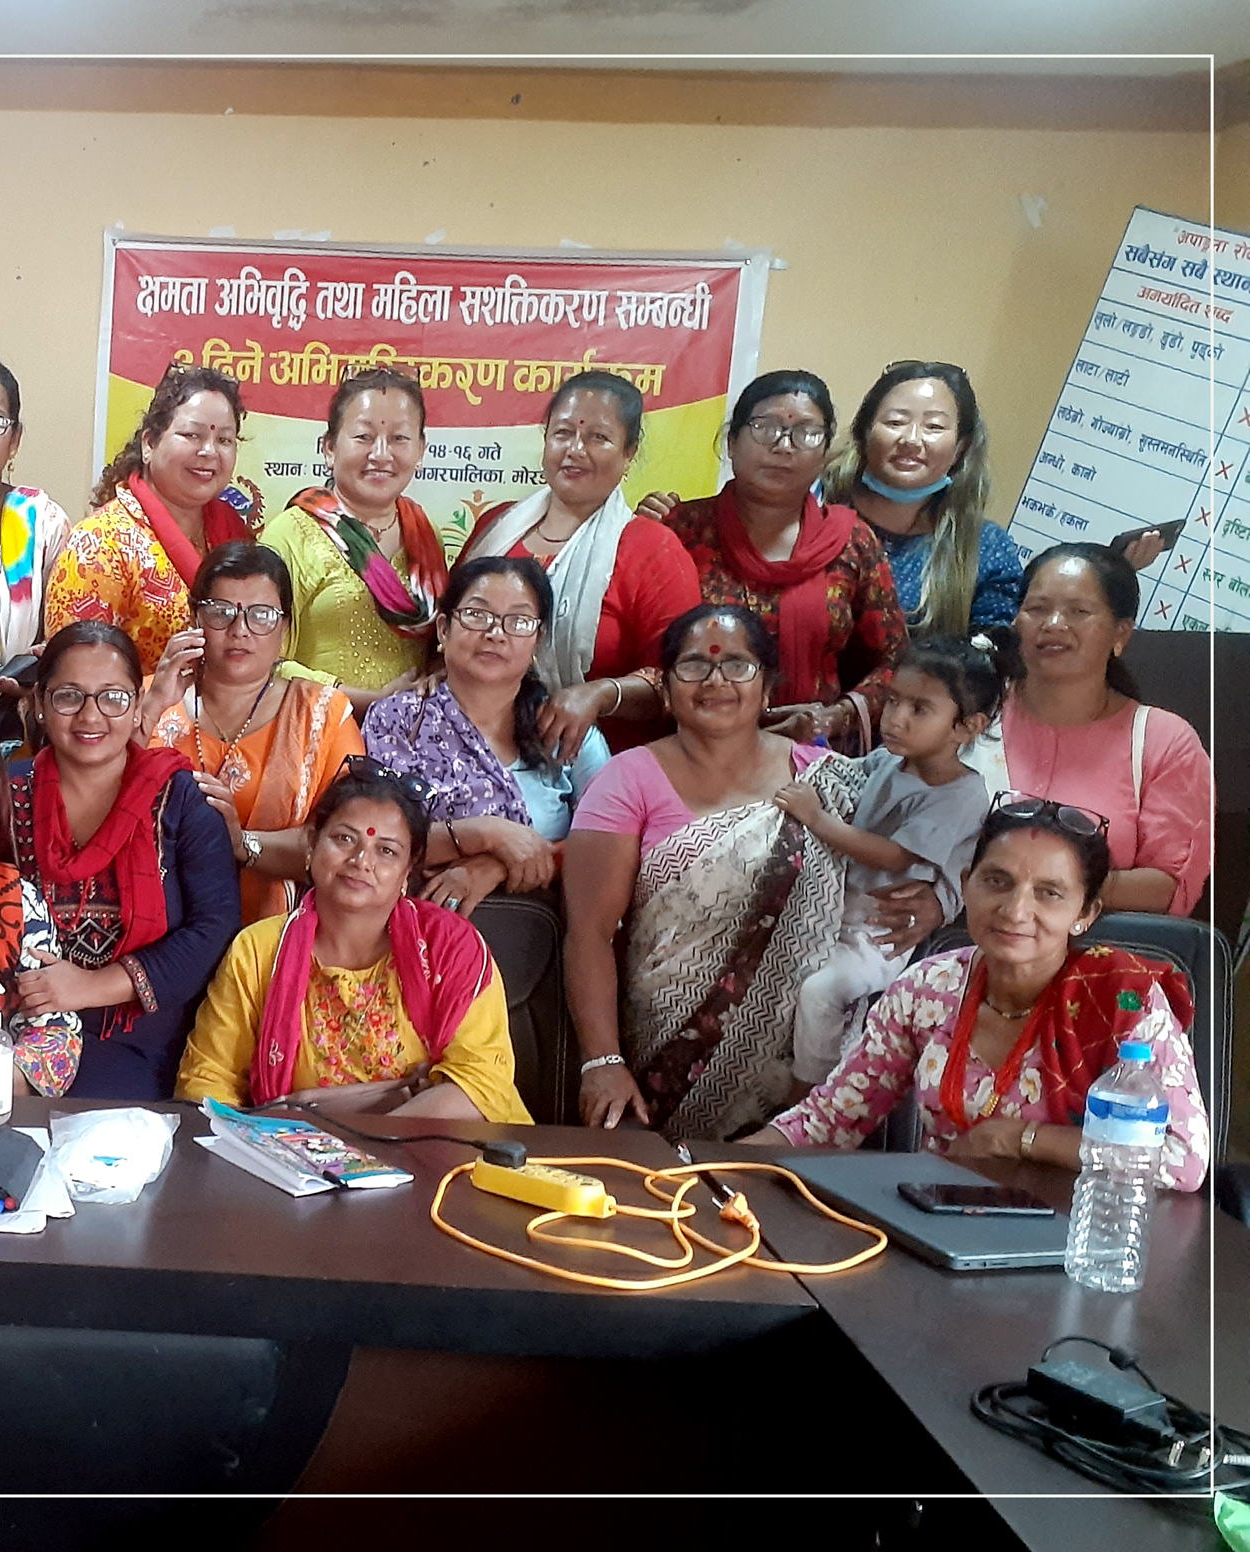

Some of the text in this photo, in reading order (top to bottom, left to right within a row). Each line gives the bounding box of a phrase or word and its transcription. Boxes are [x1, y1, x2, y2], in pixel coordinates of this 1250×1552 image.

[1181, 258, 1209, 280] सबै
[137, 266, 712, 331] क्षमता अभिवृद्धि तथा महिला सशक्तिकरण सम्बन्धी
[478, 442, 502, 460] गते
